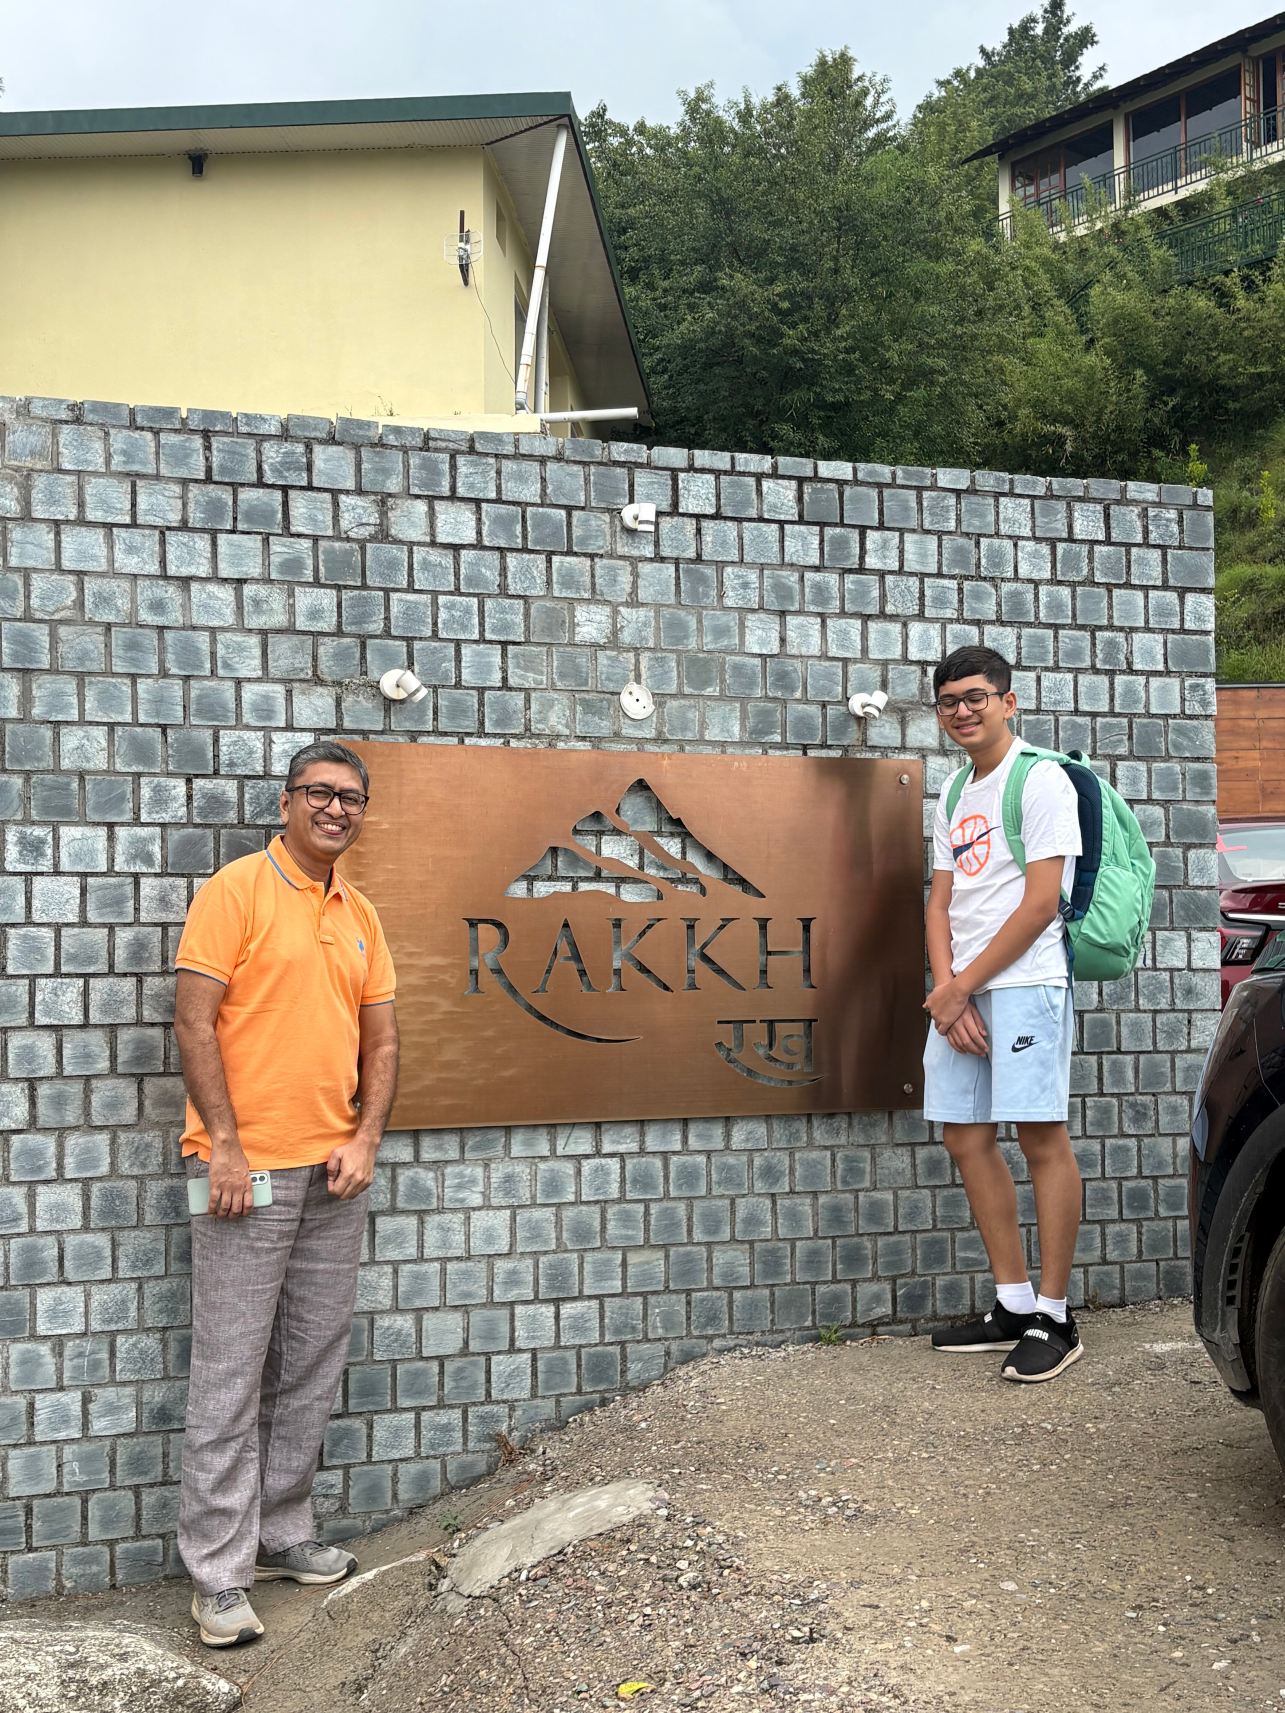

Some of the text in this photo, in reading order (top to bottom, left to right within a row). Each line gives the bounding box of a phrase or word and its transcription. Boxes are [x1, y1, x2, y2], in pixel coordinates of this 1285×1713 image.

[462, 917, 817, 1044] RAKKH
[1015, 1035, 1036, 1046] NIKE
[1022, 1328, 1049, 1341] PUMA
